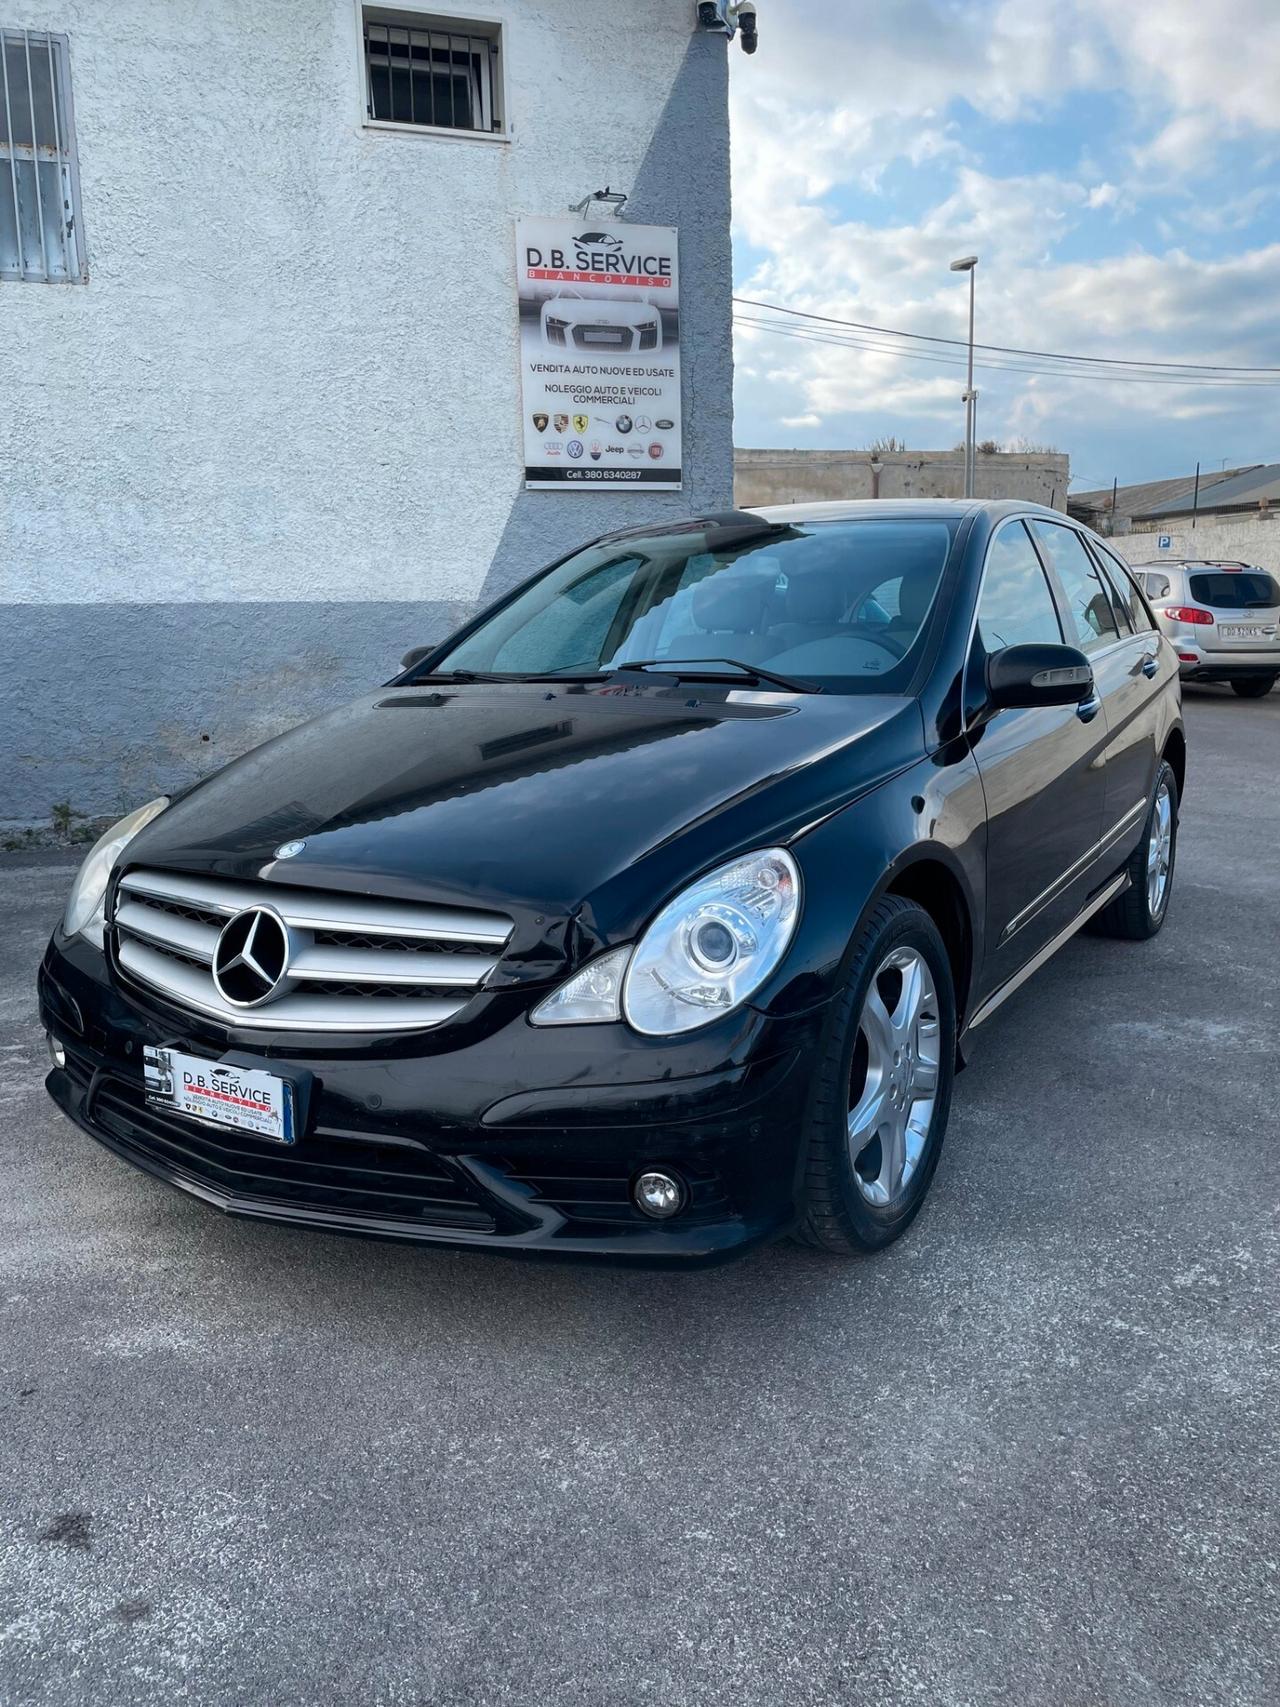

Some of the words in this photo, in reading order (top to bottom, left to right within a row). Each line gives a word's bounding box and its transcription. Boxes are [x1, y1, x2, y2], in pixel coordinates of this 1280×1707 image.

[526, 247, 570, 269] D.B.
[575, 251, 671, 276] SERVICE
[528, 271, 670, 287] BIANCOVISO
[530, 363, 571, 374] VENDITA
[572, 365, 598, 375] AUTO
[600, 366, 631, 376] NUOVE
[633, 367, 645, 376] ED
[646, 368, 675, 377] USATE
[544, 384, 592, 394] NOLEGGIO
[593, 386, 619, 395] AUTO
[620, 386, 626, 395] E
[627, 386, 662, 396] VEICOLI
[572, 395, 636, 405] COMMERCIALI
[605, 445, 624, 454] Jeep
[566, 470, 584, 479] Cell.
[585, 470, 603, 479] 380
[603, 470, 642, 480] 6340287
[1159, 537, 1169, 547] P
[183, 1071, 209, 1089] D.B.
[211, 1079, 271, 1105] SERVICE
